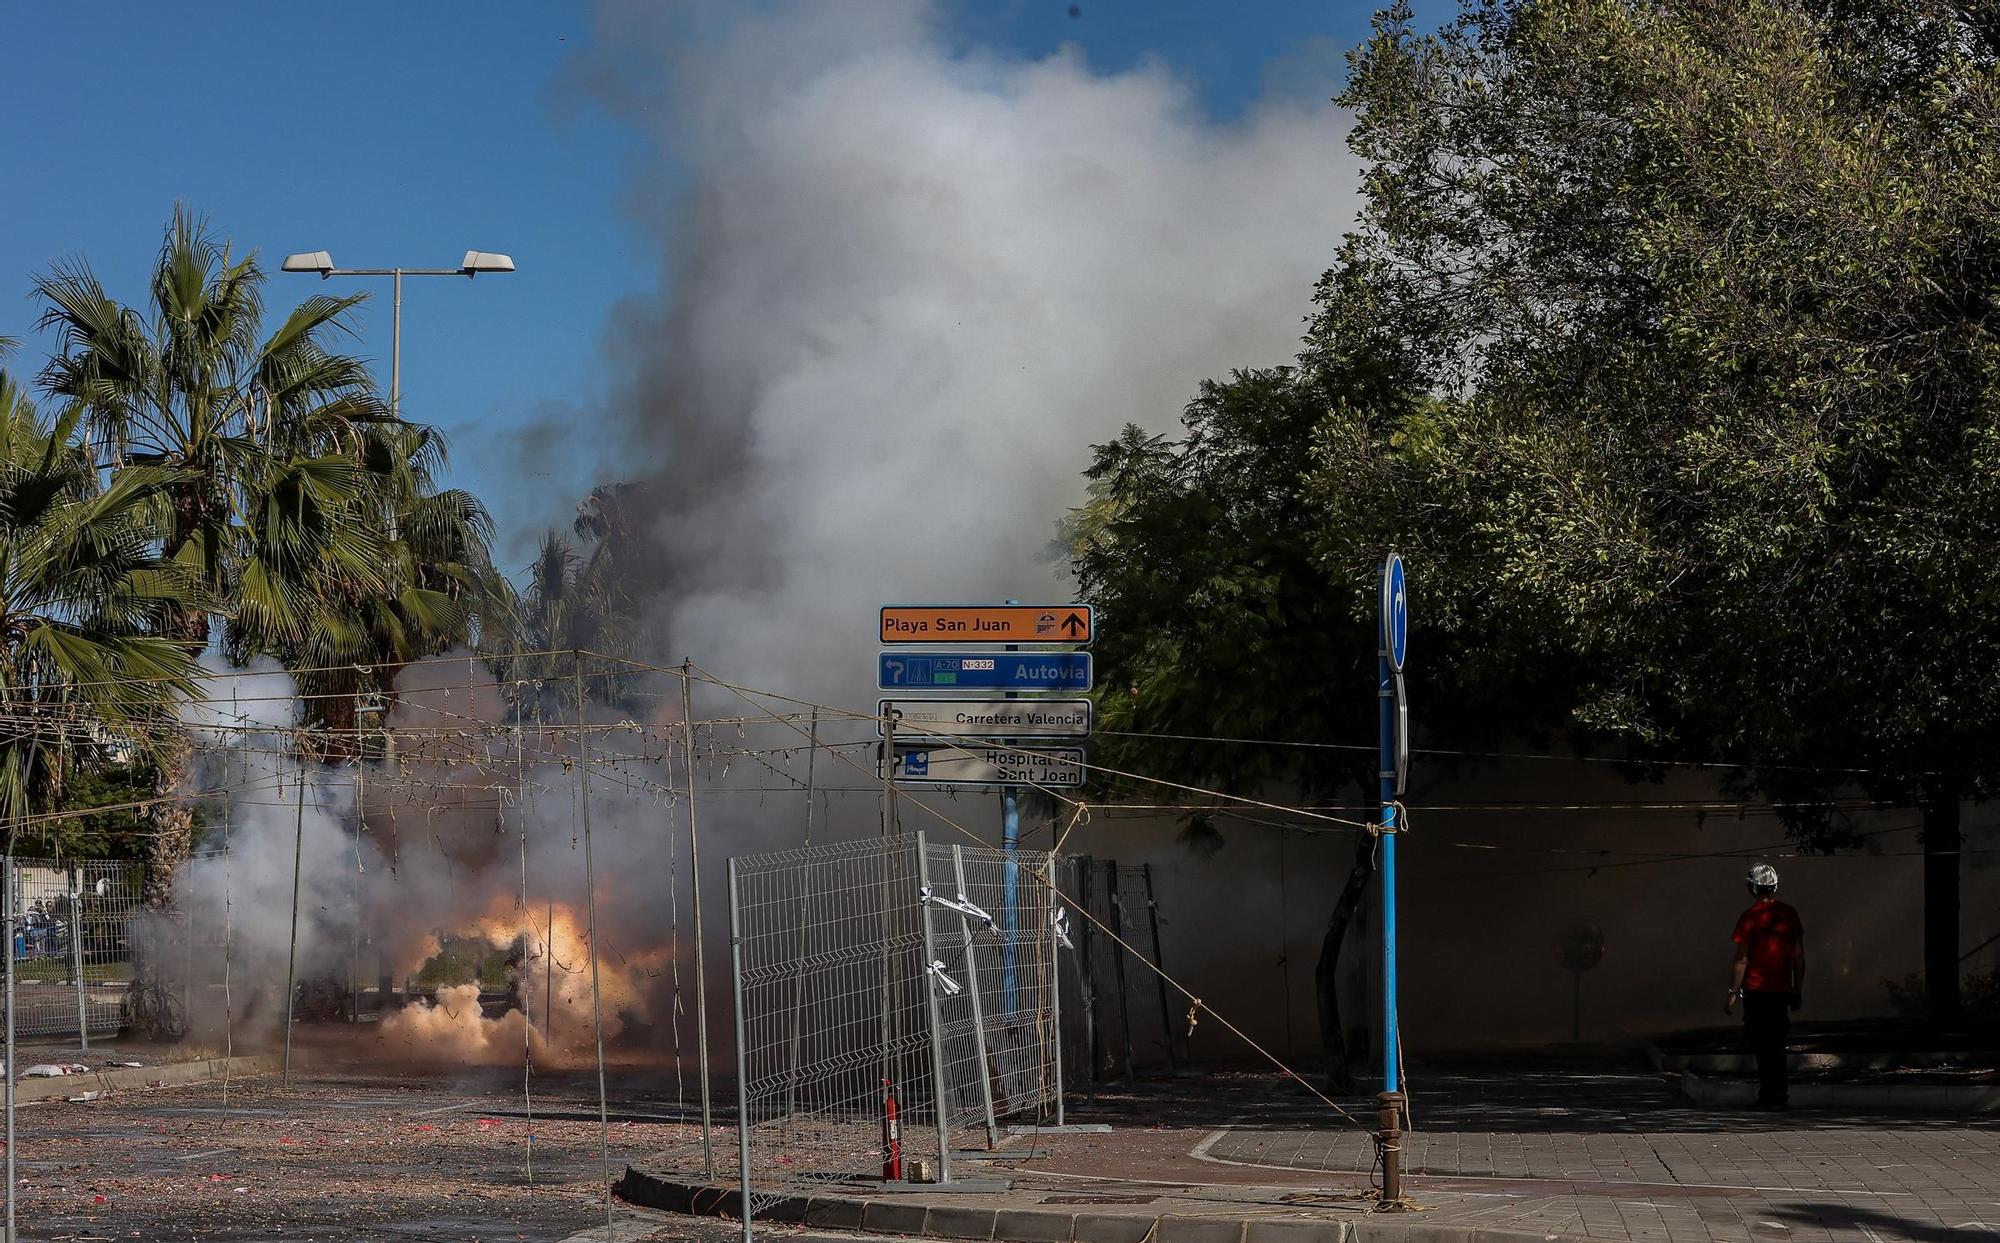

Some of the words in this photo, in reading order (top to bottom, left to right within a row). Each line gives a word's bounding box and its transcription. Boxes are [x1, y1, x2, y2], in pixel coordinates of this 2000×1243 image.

[885, 618, 928, 634] Playa
[935, 618, 966, 631] San
[973, 618, 1011, 631] Juan
[962, 660, 994, 669] N-332
[1015, 664, 1085, 680] Autovía
[956, 713, 1021, 725] Carretera
[1027, 713, 1084, 725] Valencia
[986, 751, 1053, 767] Hospital
[1059, 752, 1078, 766] de
[998, 768, 1035, 781] Sant
[1040, 769, 1078, 782] Joan
